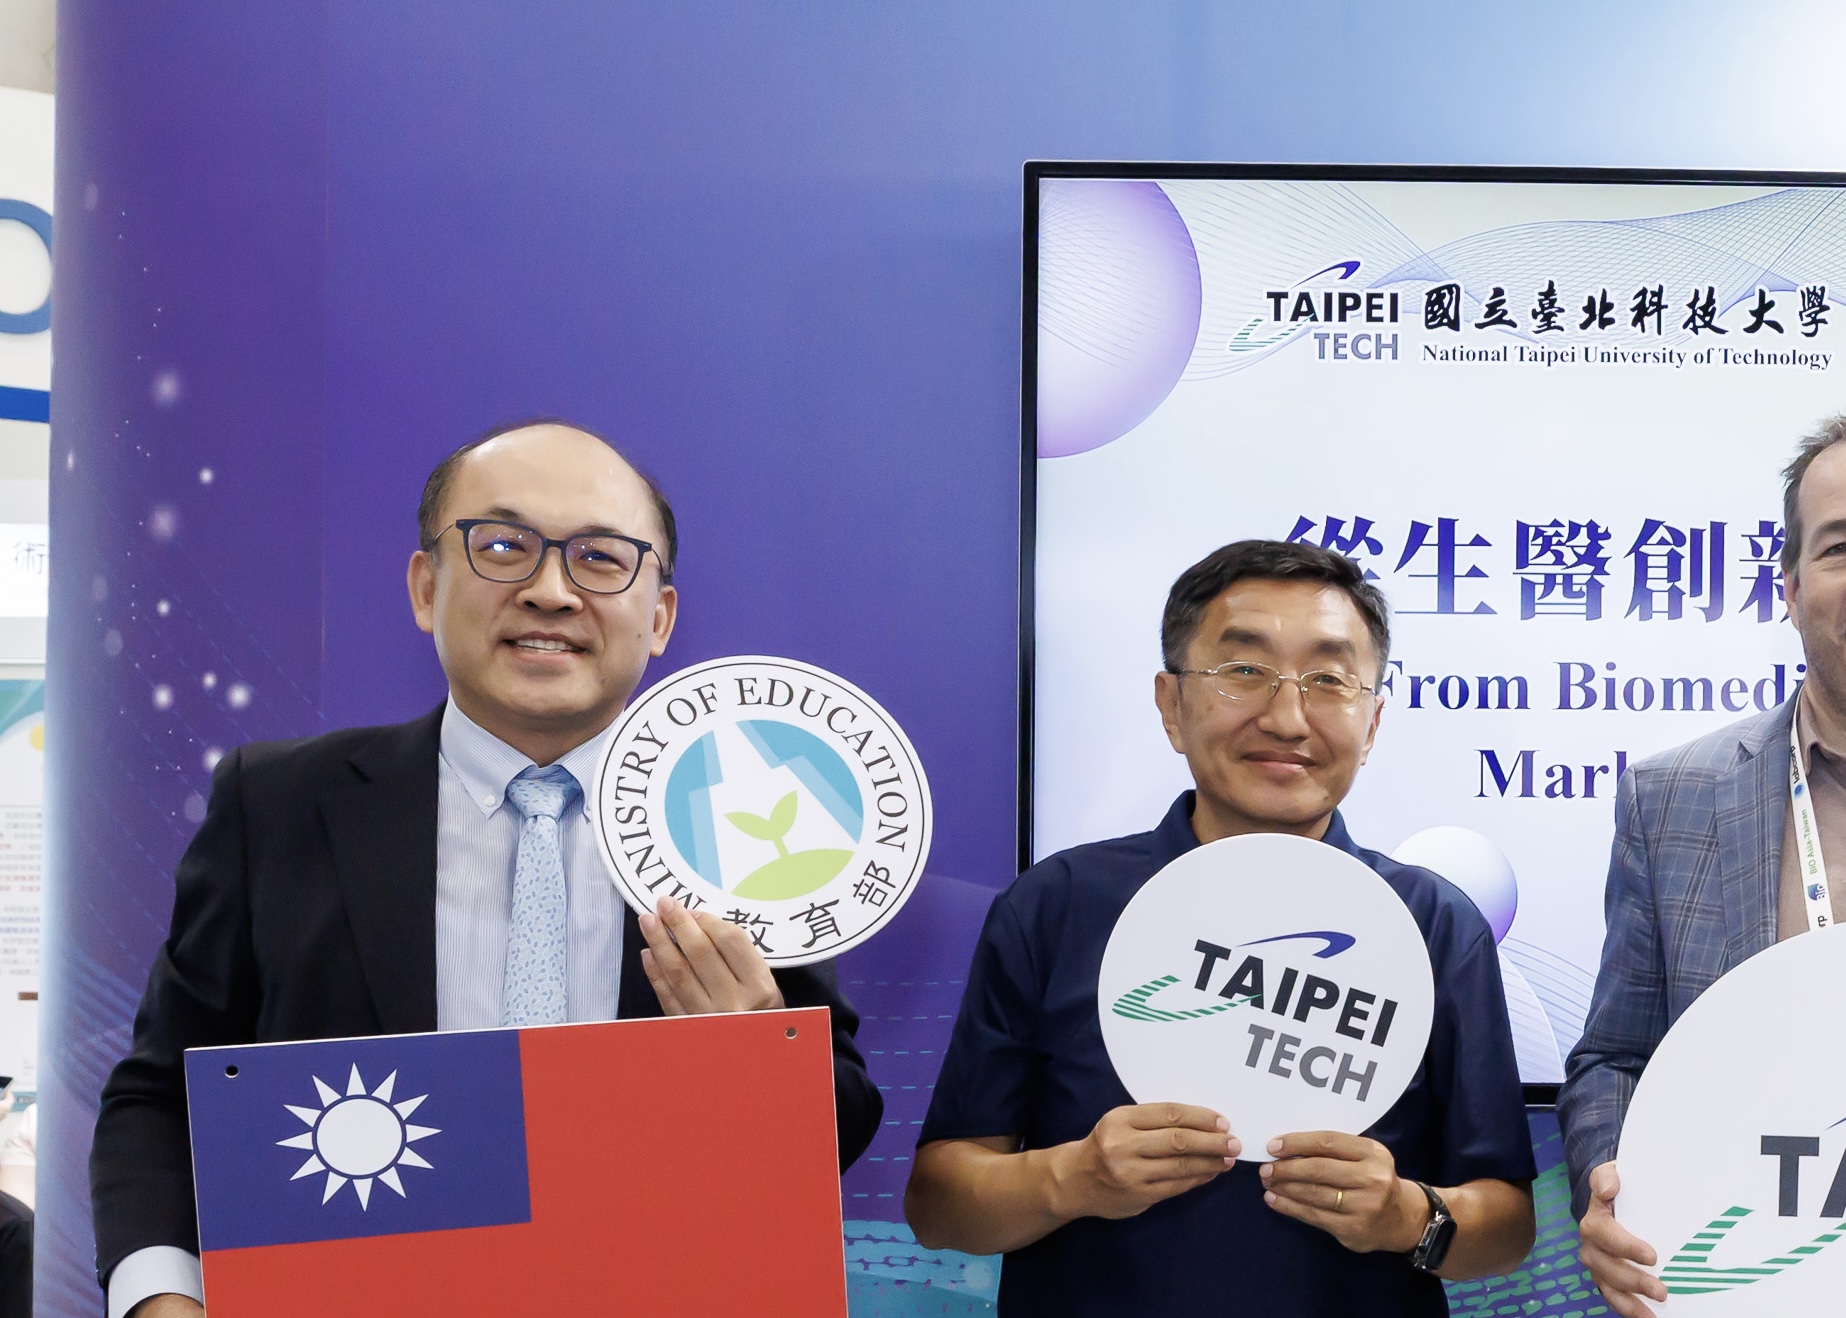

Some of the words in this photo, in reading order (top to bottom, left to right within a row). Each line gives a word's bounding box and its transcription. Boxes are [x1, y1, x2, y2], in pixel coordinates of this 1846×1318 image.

[1266, 291, 1399, 323] TAIPEI
[1424, 279, 1831, 338] 國立臺北科技大學
[1313, 332, 1399, 361] TECH
[1422, 344, 1508, 363] National
[1513, 345, 1576, 368] Taipei
[1583, 346, 1688, 369] University
[1693, 347, 1715, 366] of
[1718, 348, 1833, 371] Technology
[1555, 661, 1807, 713] Biomedi
[666, 682, 718, 727] OF
[733, 677, 909, 853] EDUCATION
[722, 860, 896, 953] 教育部
[1193, 938, 1399, 1049] TAIPEI
[1245, 1023, 1379, 1103] TECH
